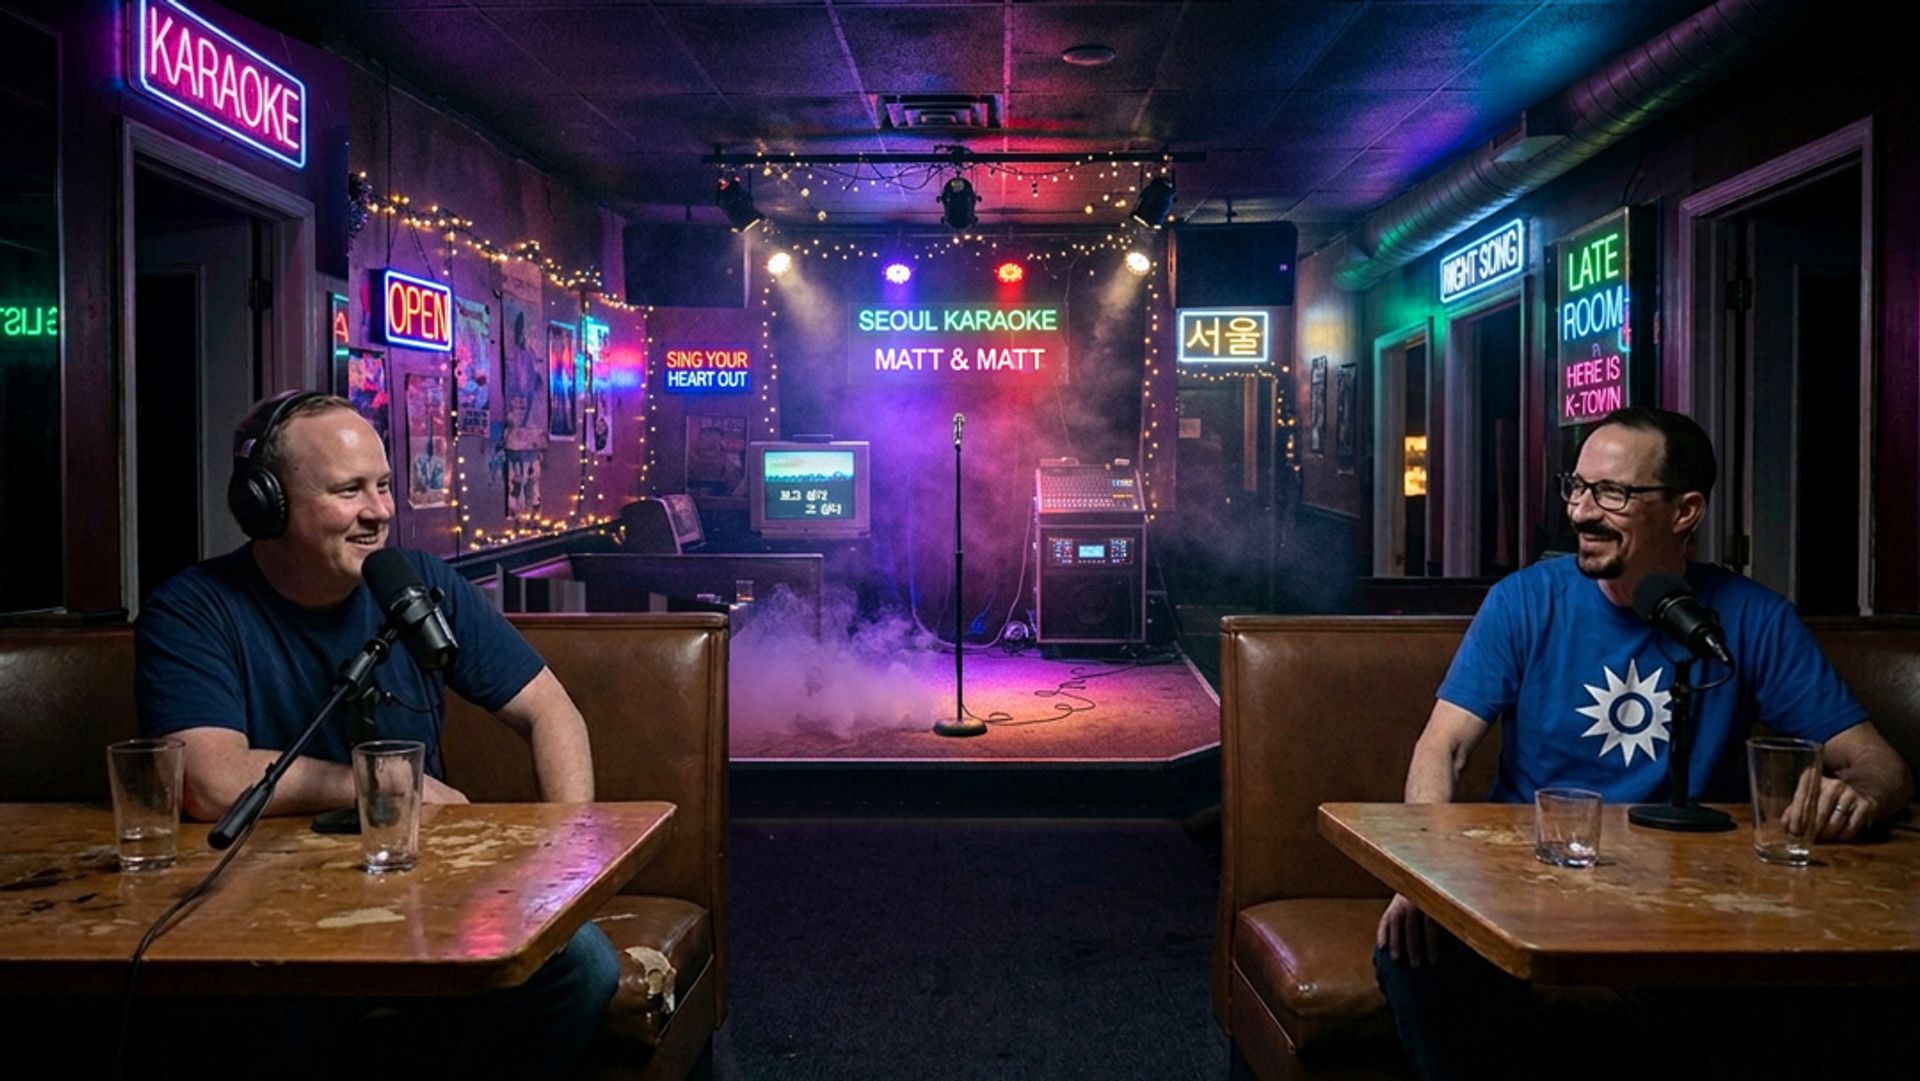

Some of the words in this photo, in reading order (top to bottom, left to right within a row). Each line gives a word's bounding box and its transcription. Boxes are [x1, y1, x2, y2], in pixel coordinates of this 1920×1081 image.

[151, 7, 299, 149] KARAOKE
[1479, 229, 1517, 279] SONG
[1568, 233, 1619, 292] LATE
[390, 282, 448, 342] OPEN
[859, 310, 938, 331] SEOUL
[944, 310, 1057, 331] KARAOKE
[1563, 285, 1623, 341] ROOM
[1186, 317, 1260, 356] 서울
[666, 351, 703, 368] SING
[706, 351, 748, 368] YOUR
[875, 348, 944, 370] MATT
[950, 347, 969, 371] &
[977, 348, 1045, 370] MATT
[1567, 359, 1603, 389] HERE
[1606, 355, 1620, 380] IS
[668, 371, 715, 387] HEART
[718, 371, 747, 387] OUT
